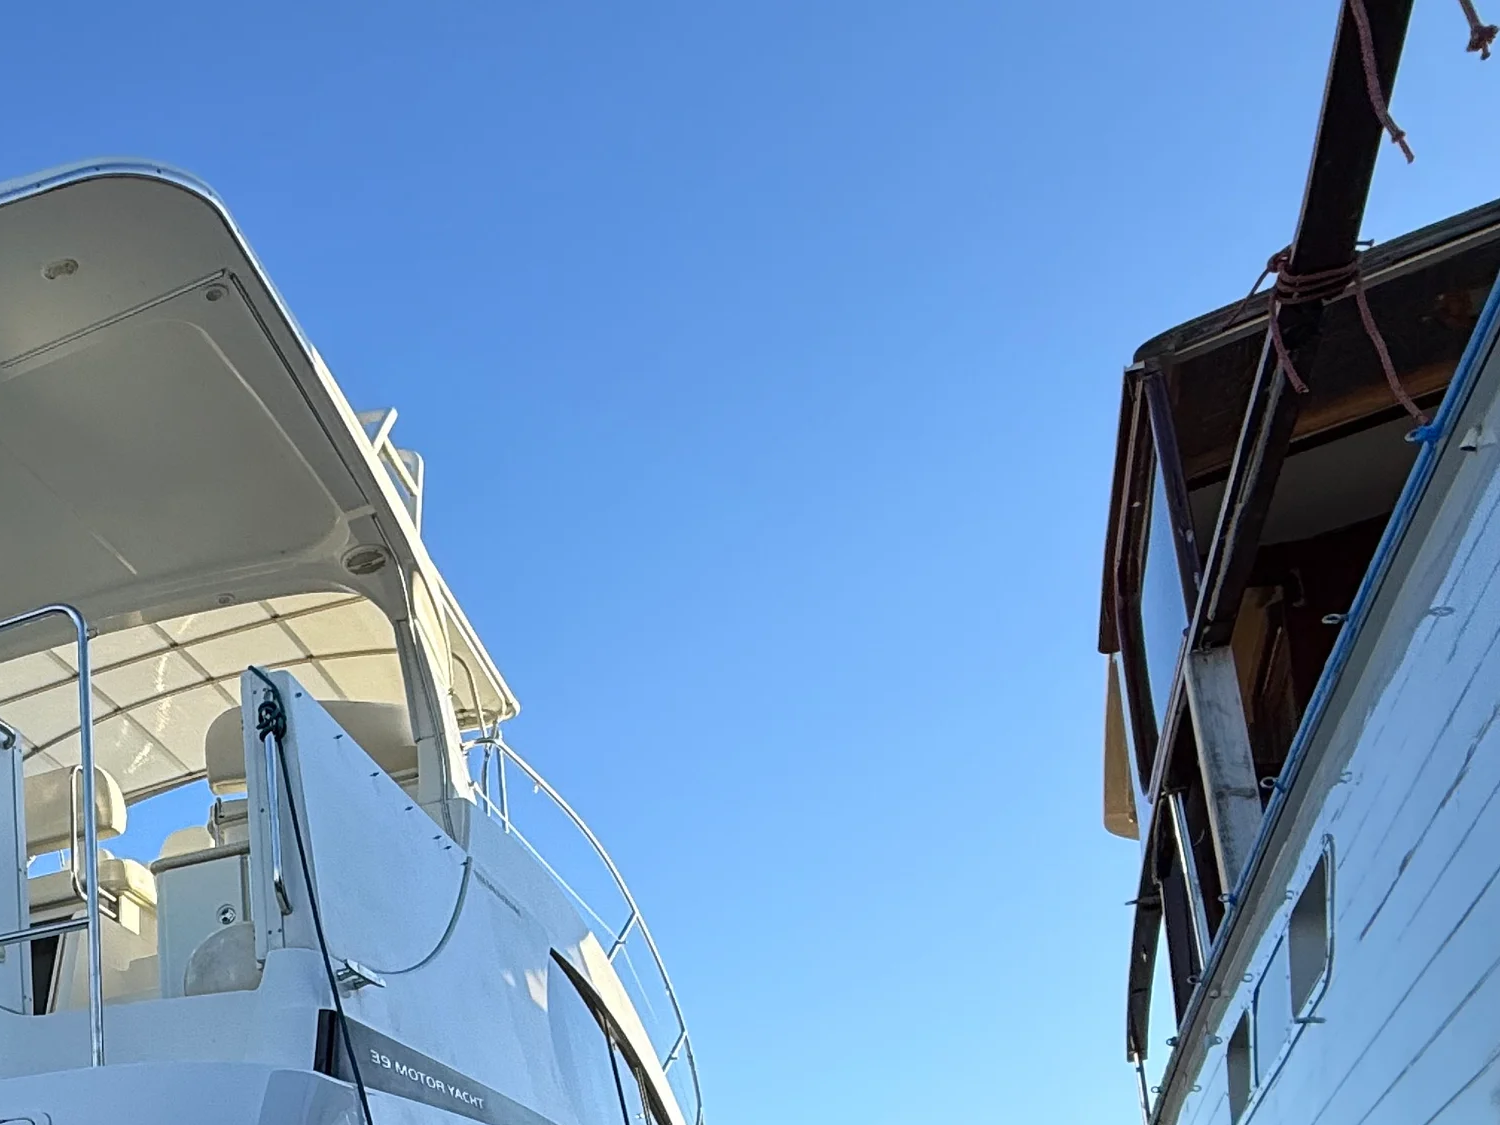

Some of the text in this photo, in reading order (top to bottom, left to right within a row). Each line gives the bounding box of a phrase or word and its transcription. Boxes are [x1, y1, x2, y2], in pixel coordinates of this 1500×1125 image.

[370, 1049, 485, 1109] 39 MOTOR YACHT
